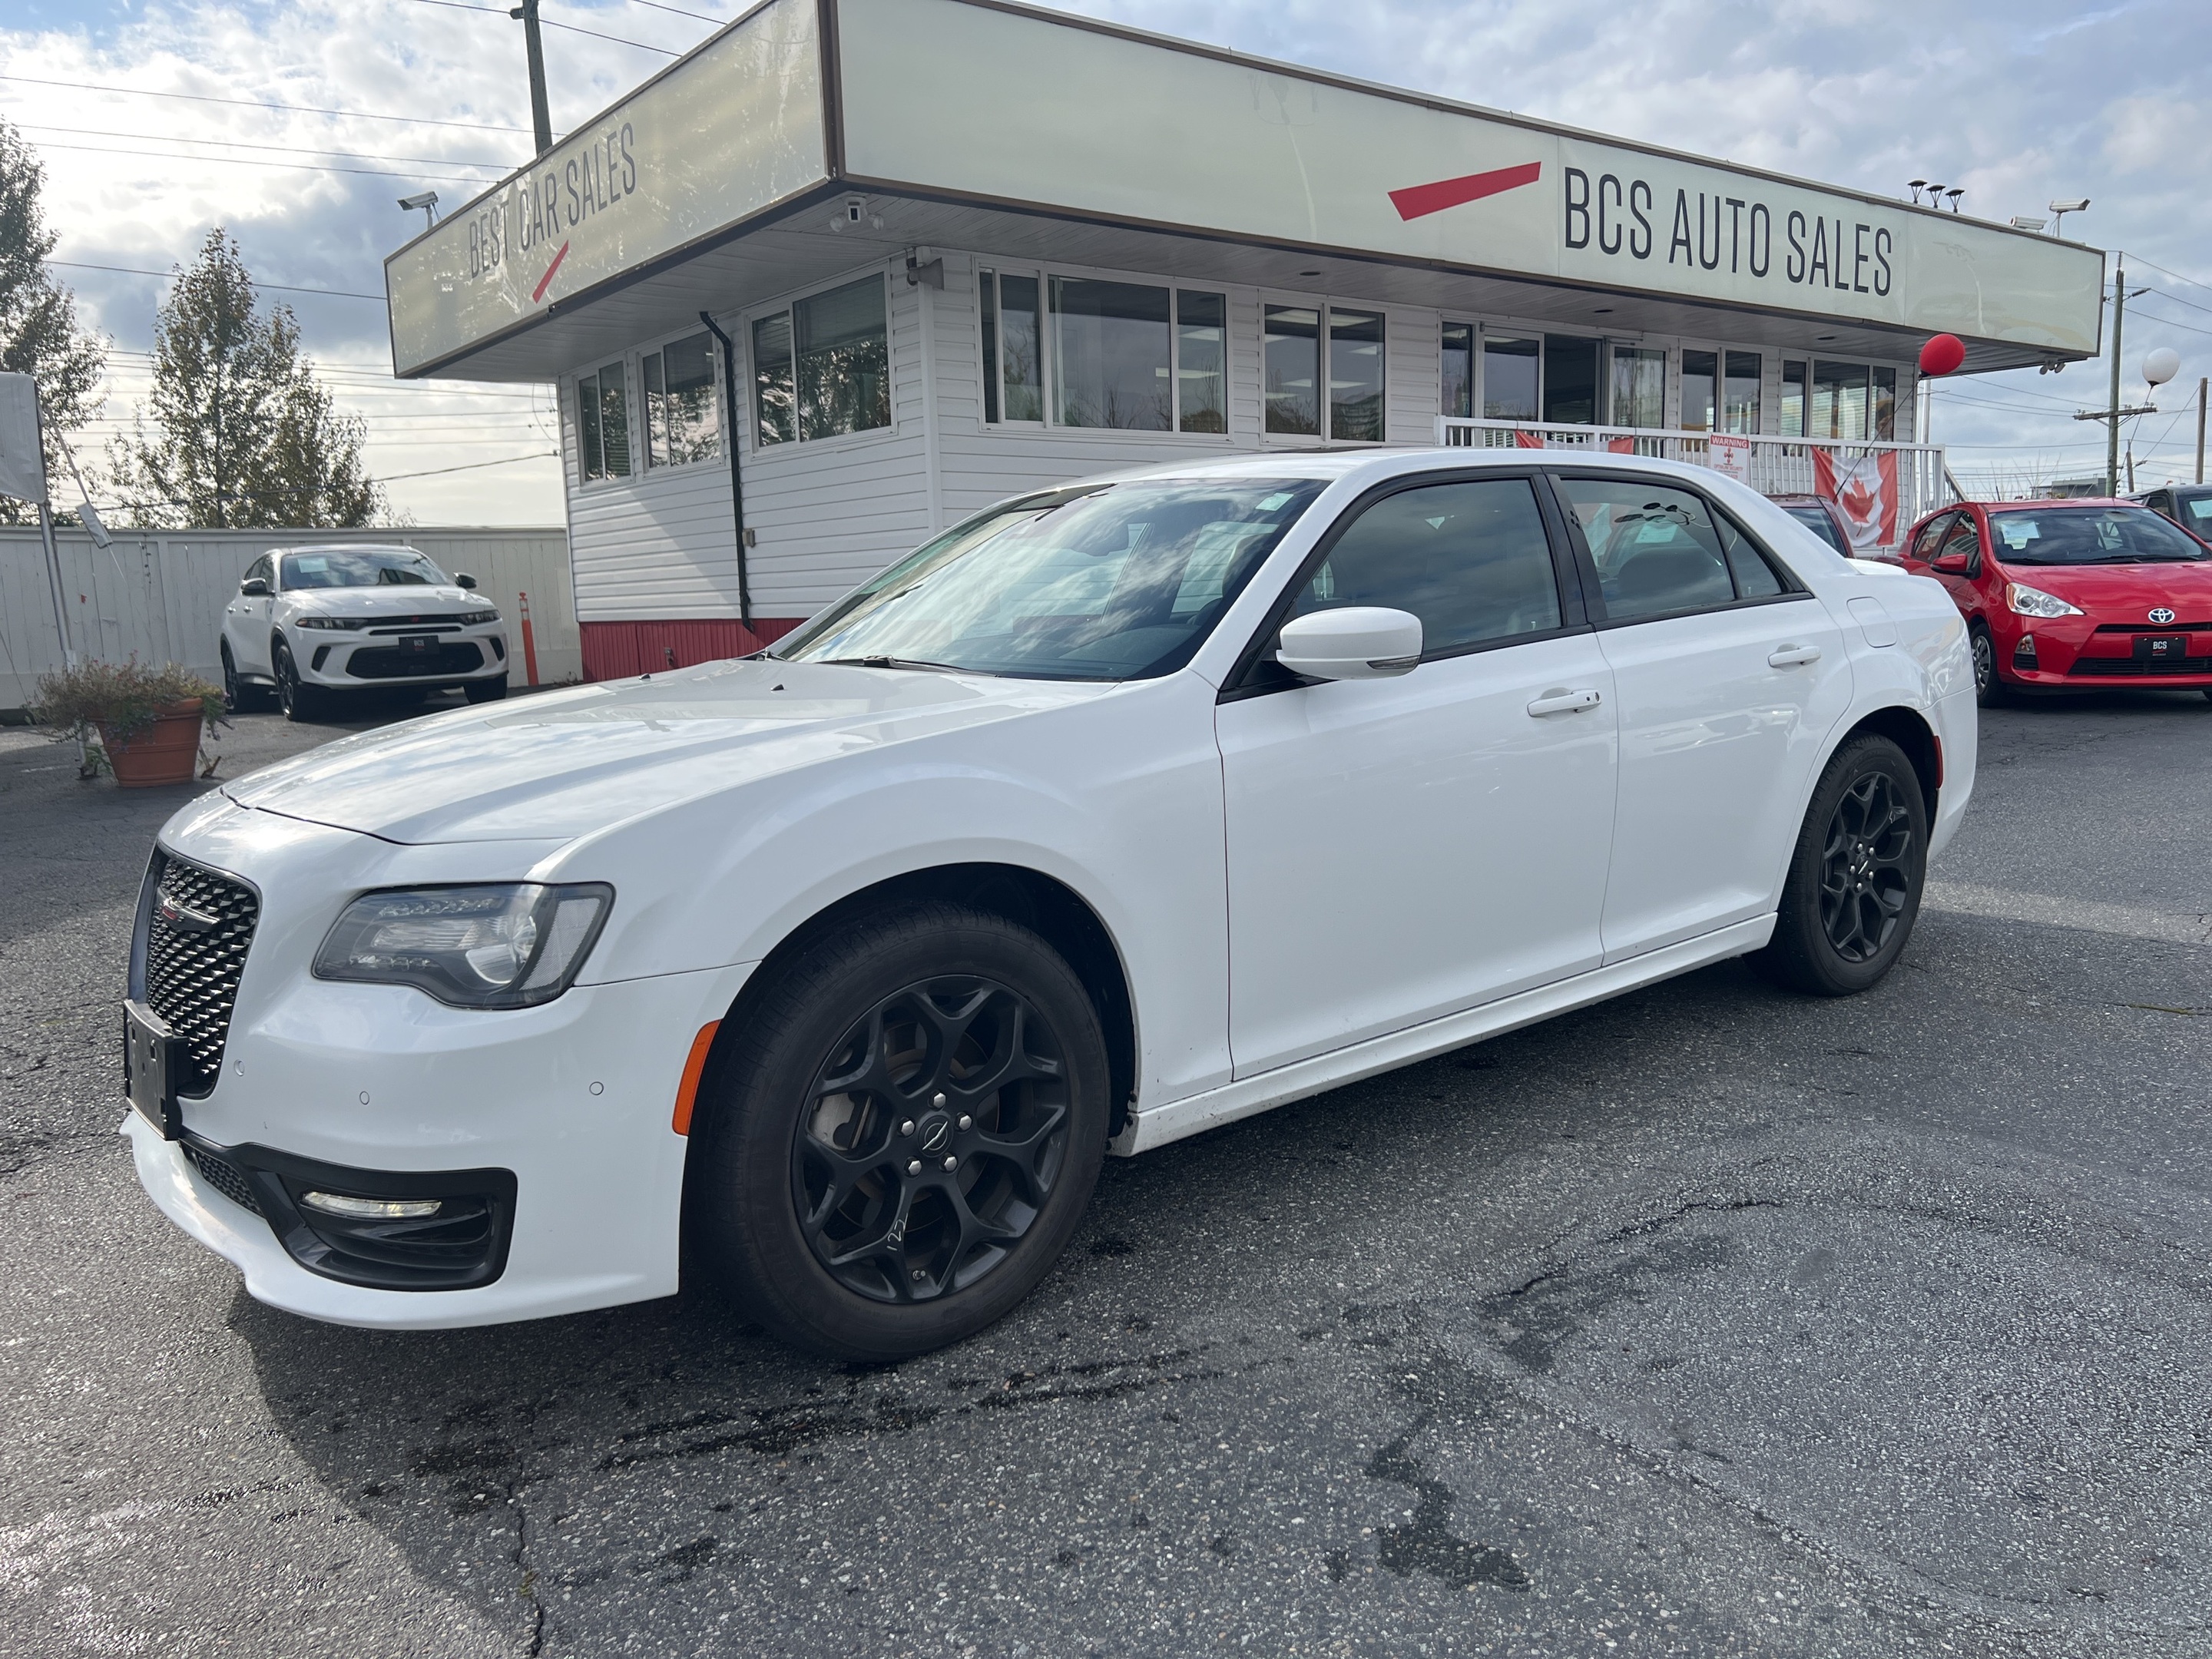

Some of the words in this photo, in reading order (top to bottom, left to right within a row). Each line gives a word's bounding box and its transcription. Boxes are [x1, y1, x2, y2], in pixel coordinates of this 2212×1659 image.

[469, 199, 509, 279] BEST
[519, 172, 560, 251] CAR
[566, 122, 636, 226] SALES
[1565, 167, 1652, 260] BCS
[1668, 188, 1770, 277] AUTO
[1786, 210, 1892, 296] SALES
[1712, 436, 1747, 448] WARNING
